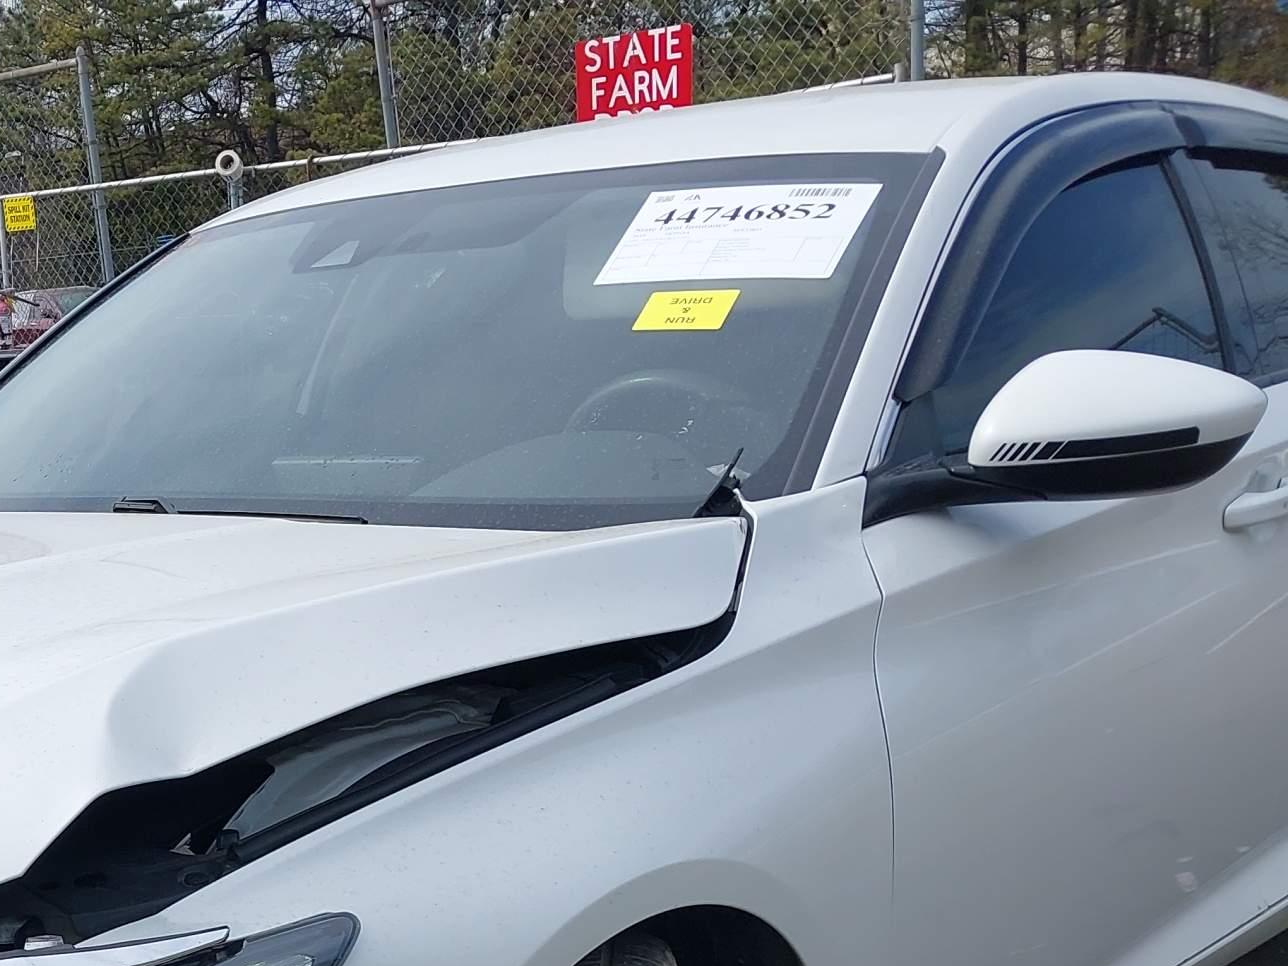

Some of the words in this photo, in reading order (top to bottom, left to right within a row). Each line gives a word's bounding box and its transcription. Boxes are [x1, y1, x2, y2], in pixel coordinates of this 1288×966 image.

[584, 25, 682, 72] STATE
[591, 65, 678, 110] FARM
[654, 203, 836, 224] 44746852
